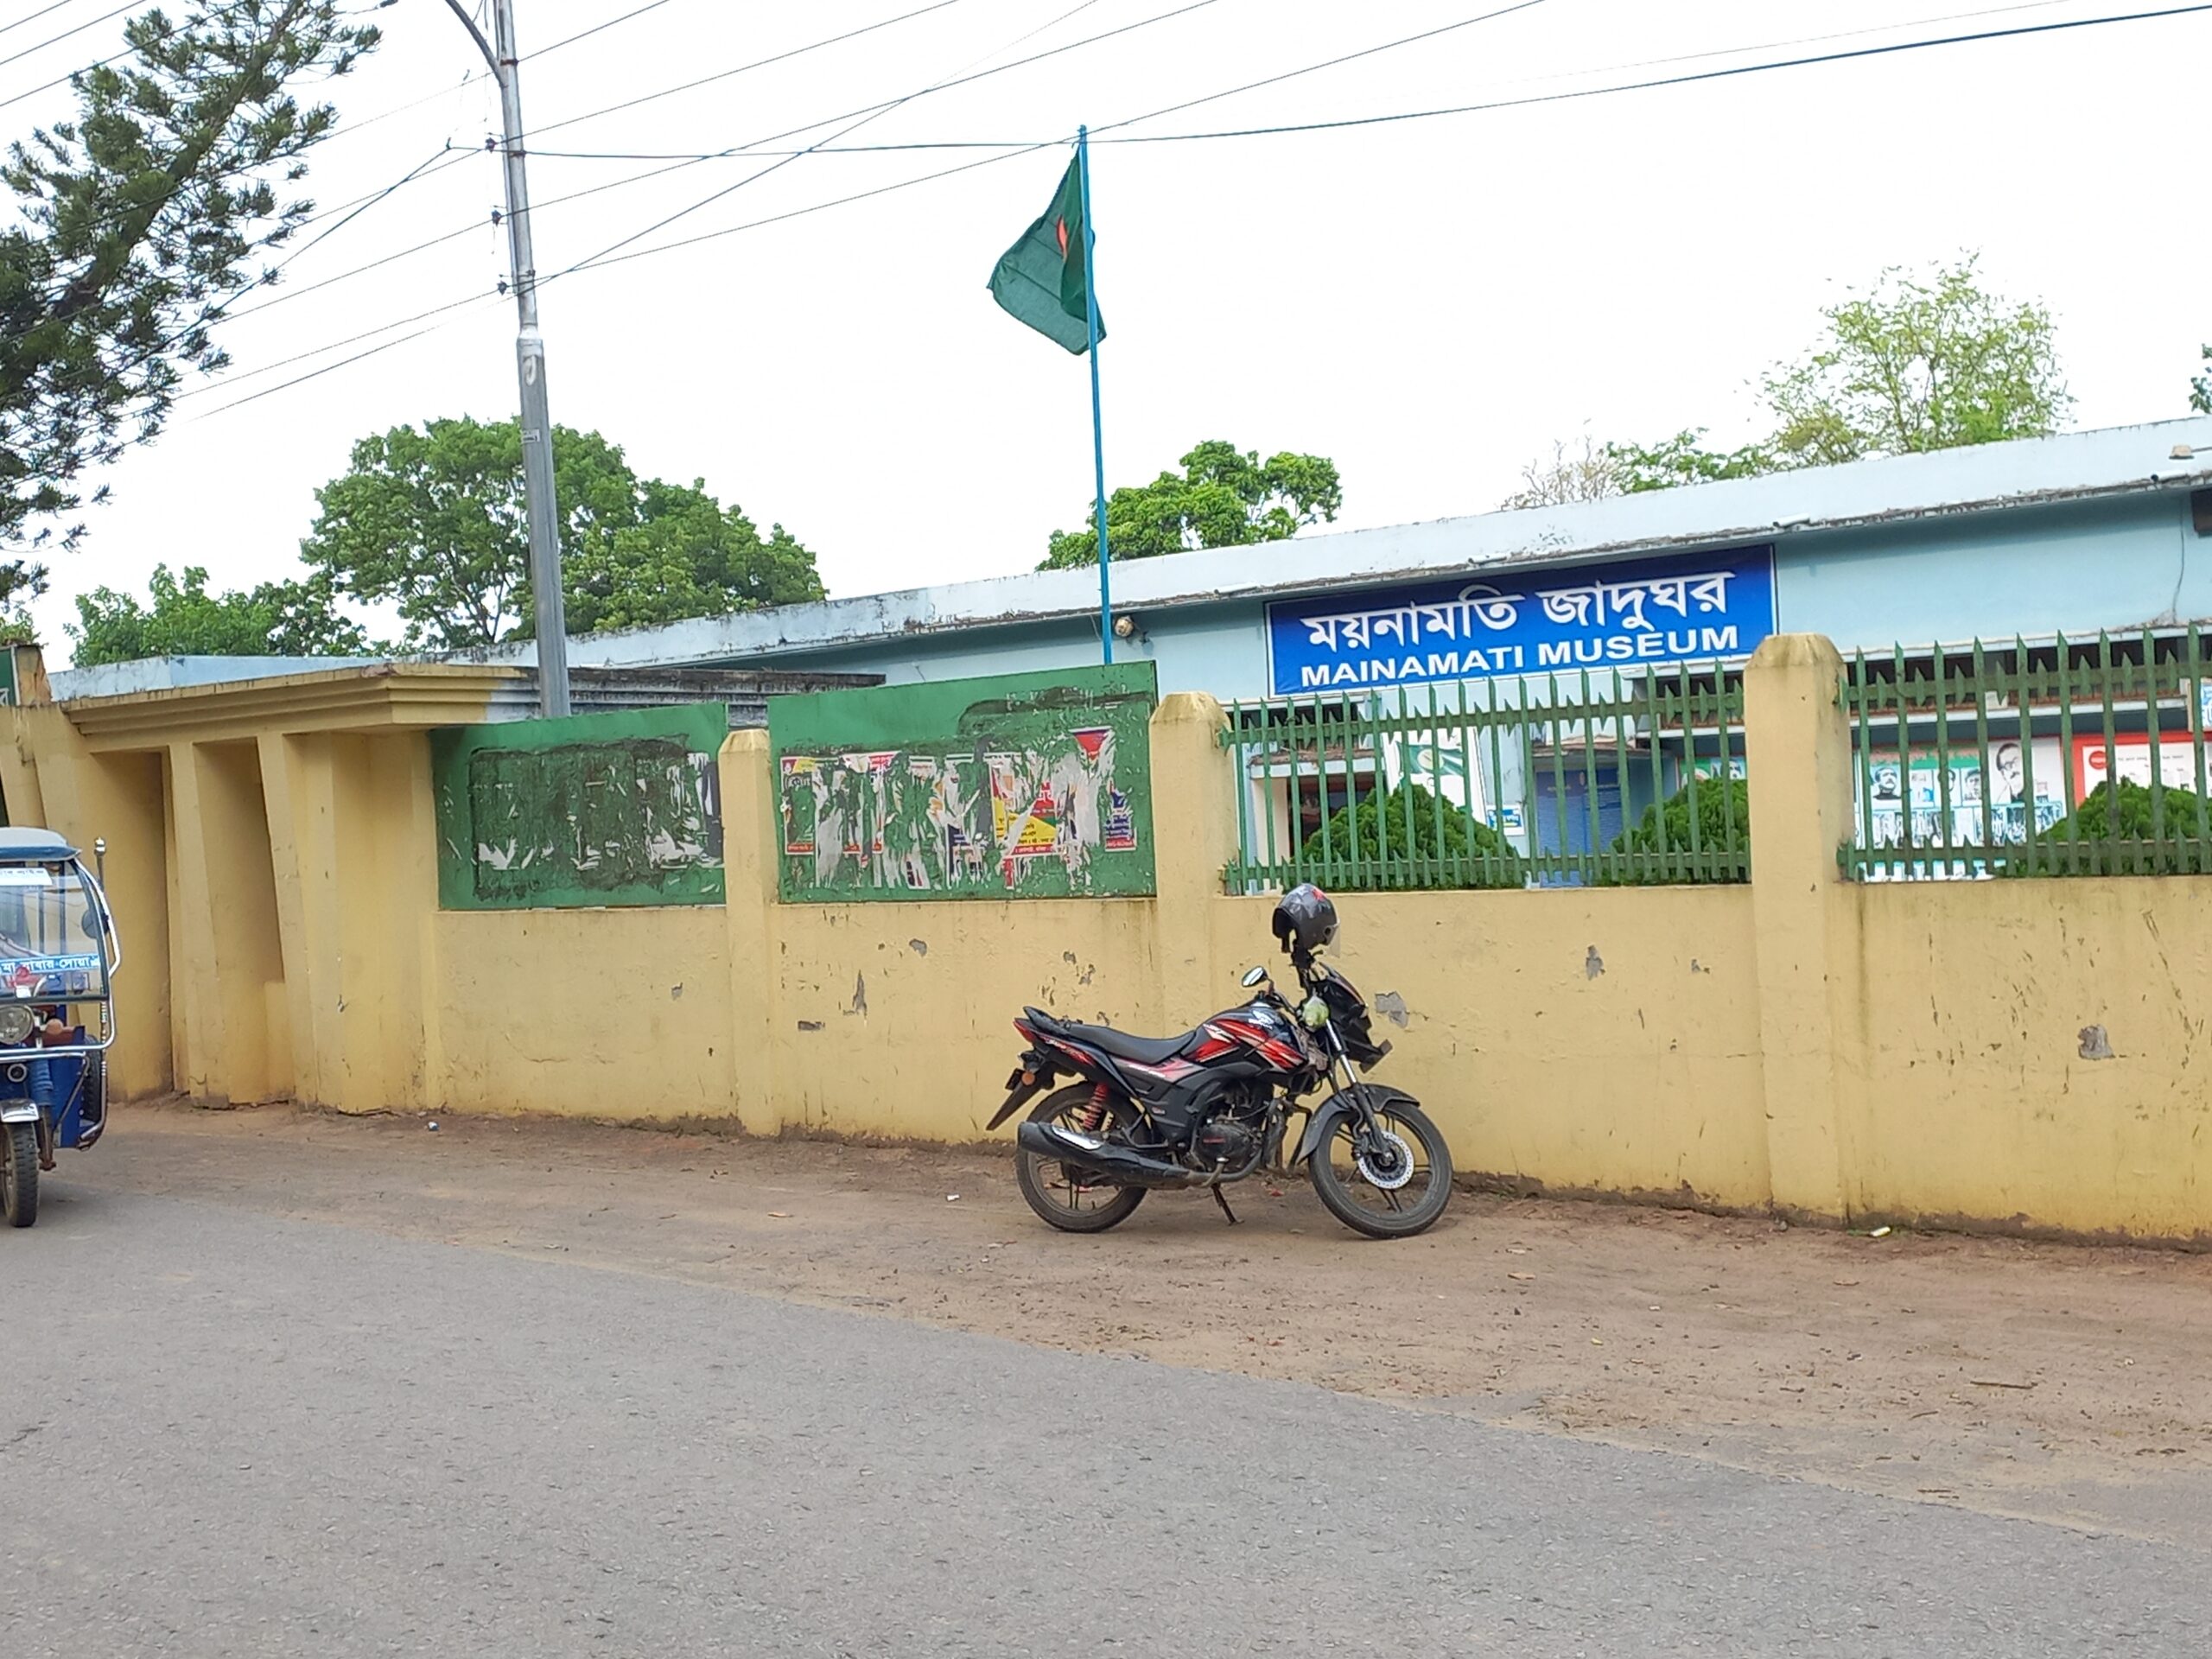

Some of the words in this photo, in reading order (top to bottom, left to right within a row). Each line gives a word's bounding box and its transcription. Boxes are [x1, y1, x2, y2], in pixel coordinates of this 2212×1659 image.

[1300, 584, 1526, 653] ময়নামতি
[1535, 571, 1736, 632] জাদুঘর
[1301, 645, 1524, 687] MAINAMATI
[1538, 626, 1738, 665] MUSEUM
